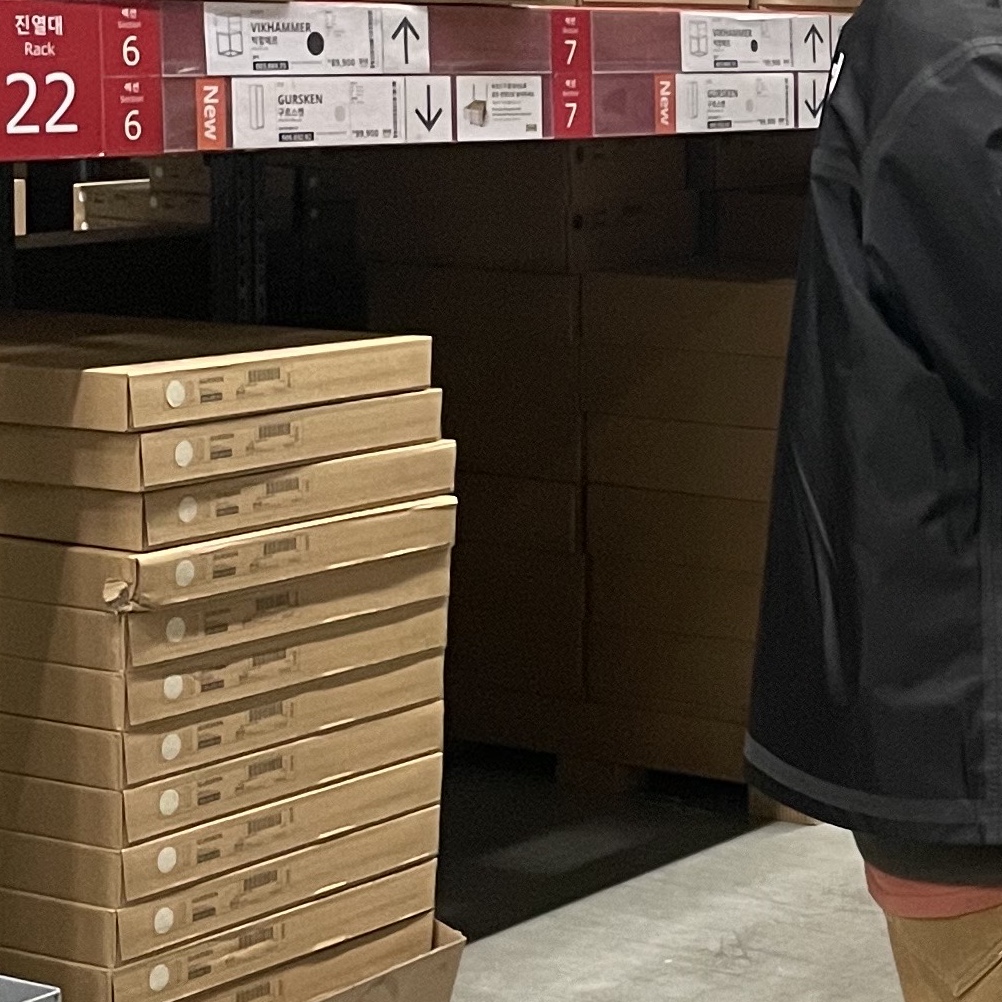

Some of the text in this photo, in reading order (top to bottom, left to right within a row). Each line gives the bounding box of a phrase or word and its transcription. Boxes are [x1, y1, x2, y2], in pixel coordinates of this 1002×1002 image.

[15, 14, 64, 36] 진열대
[250, 22, 312, 33] VIKHAMMER
[24, 42, 56, 56] Rack
[122, 35, 140, 66] 6
[564, 39, 577, 65] 7
[6, 71, 79, 135] 22
[277, 93, 323, 105] GURSKEN
[659, 80, 672, 126] New
[124, 109, 142, 141] 6
[202, 85, 219, 141] New
[564, 102, 577, 129] 7
